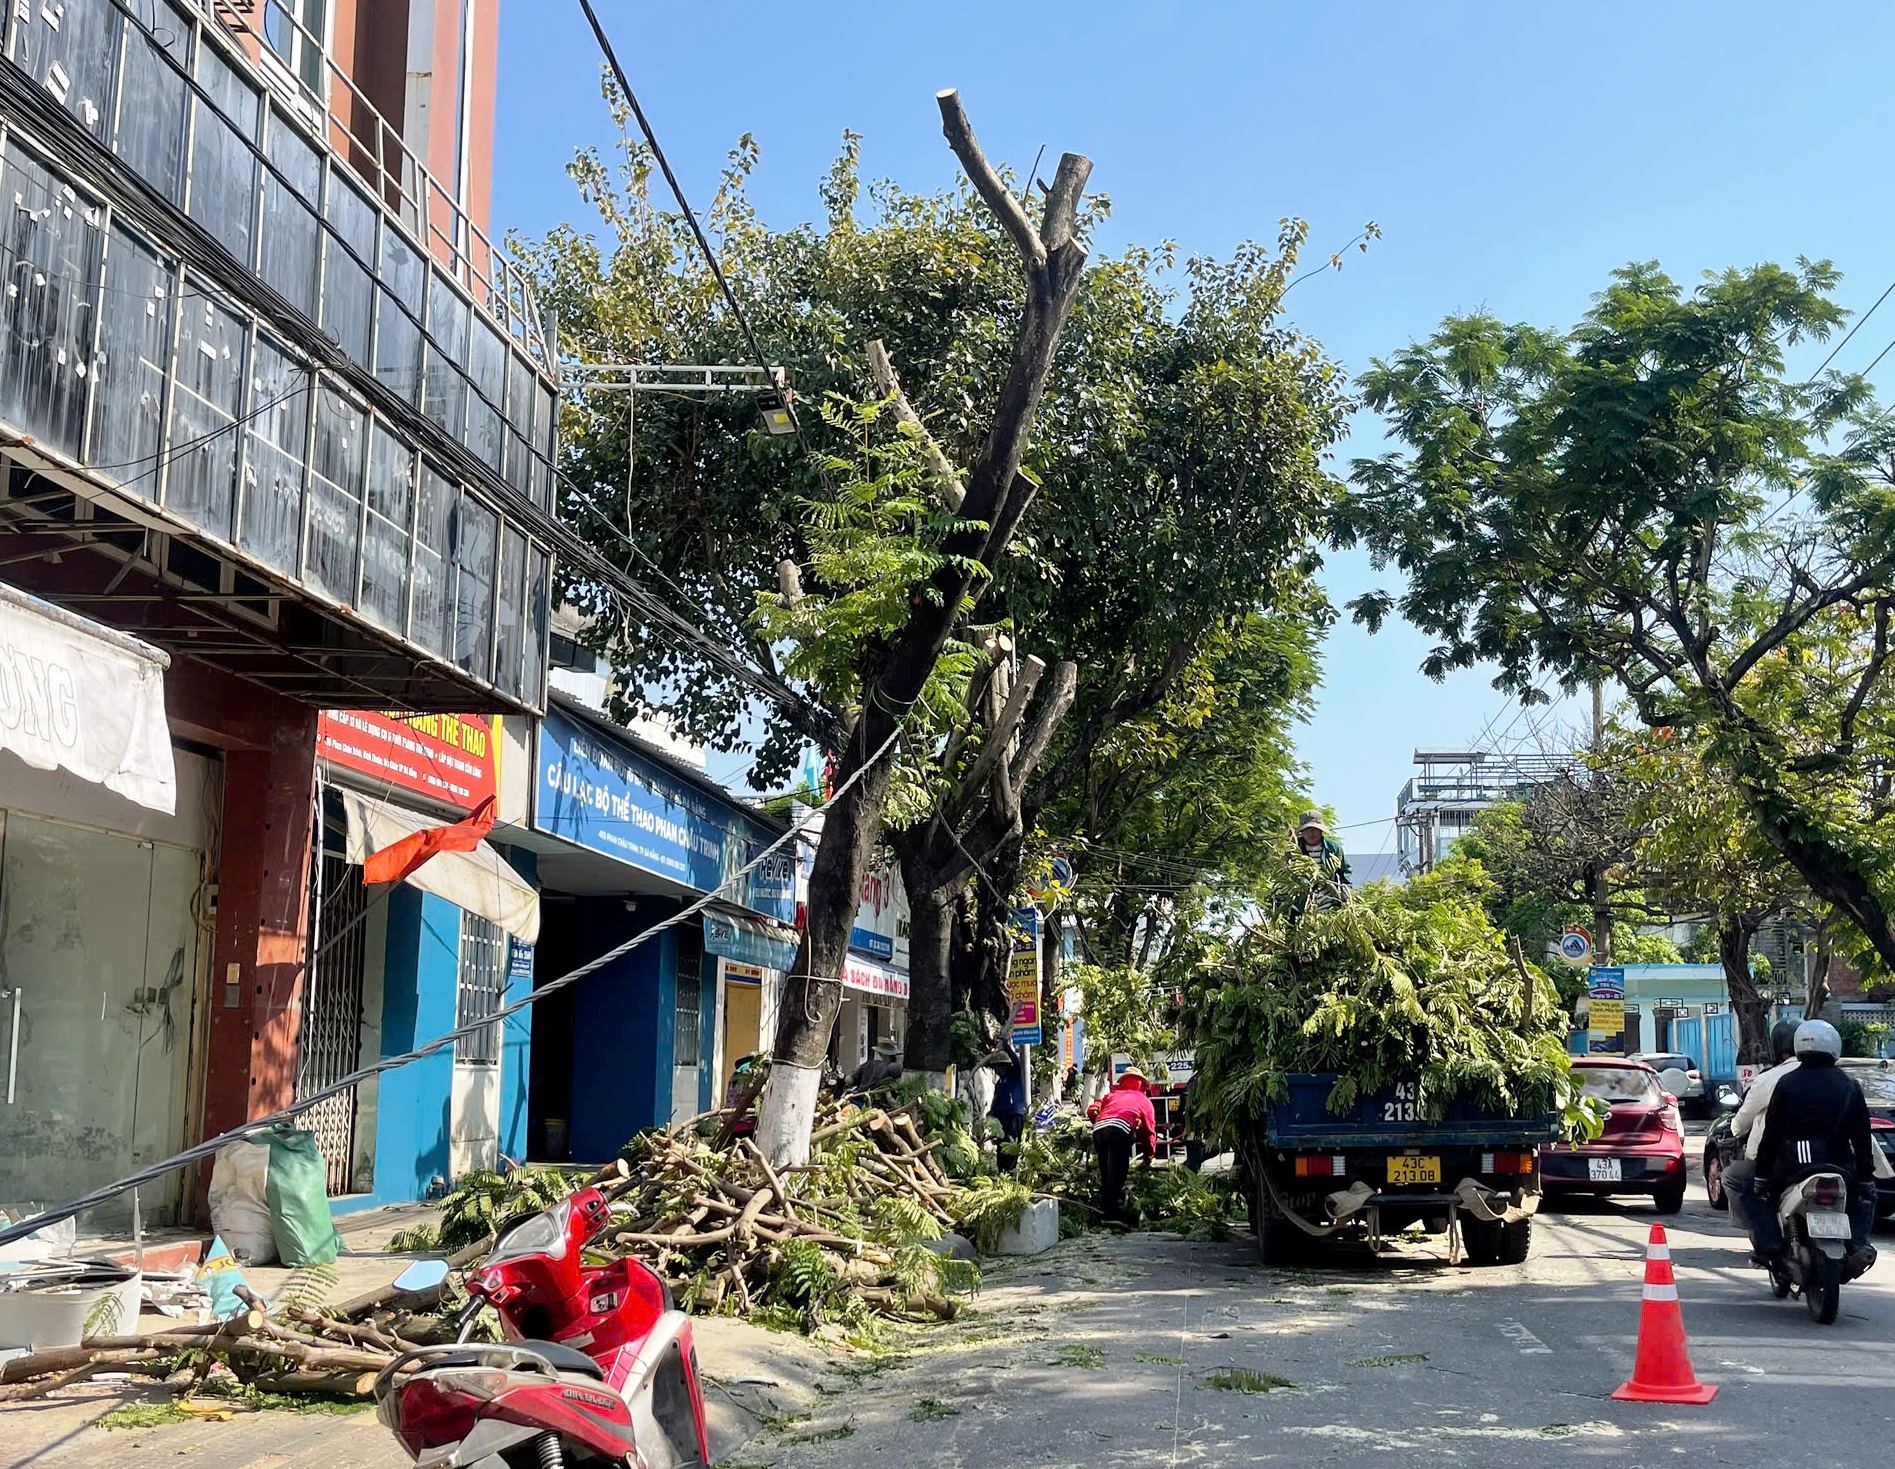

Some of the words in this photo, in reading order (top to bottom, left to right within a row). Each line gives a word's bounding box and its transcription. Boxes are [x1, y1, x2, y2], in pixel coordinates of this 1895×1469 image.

[461, 721, 487, 760] THAO
[573, 776, 593, 808] LẠC
[595, 785, 610, 817] BỘ
[611, 790, 630, 822] THỂ
[631, 803, 655, 833] THAO
[655, 816, 677, 843] PHAN
[678, 826, 699, 852] CHÂU
[699, 837, 720, 863] TRINH
[883, 872, 890, 909] 3
[850, 967, 870, 988] SÁCH
[885, 975, 903, 995] NẴNG
[1402, 1158, 1425, 1169] 43C
[1597, 1159, 1613, 1170] 43A
[1393, 1171, 1435, 1182] 213.08
[562, 1389, 583, 1401] AIR
